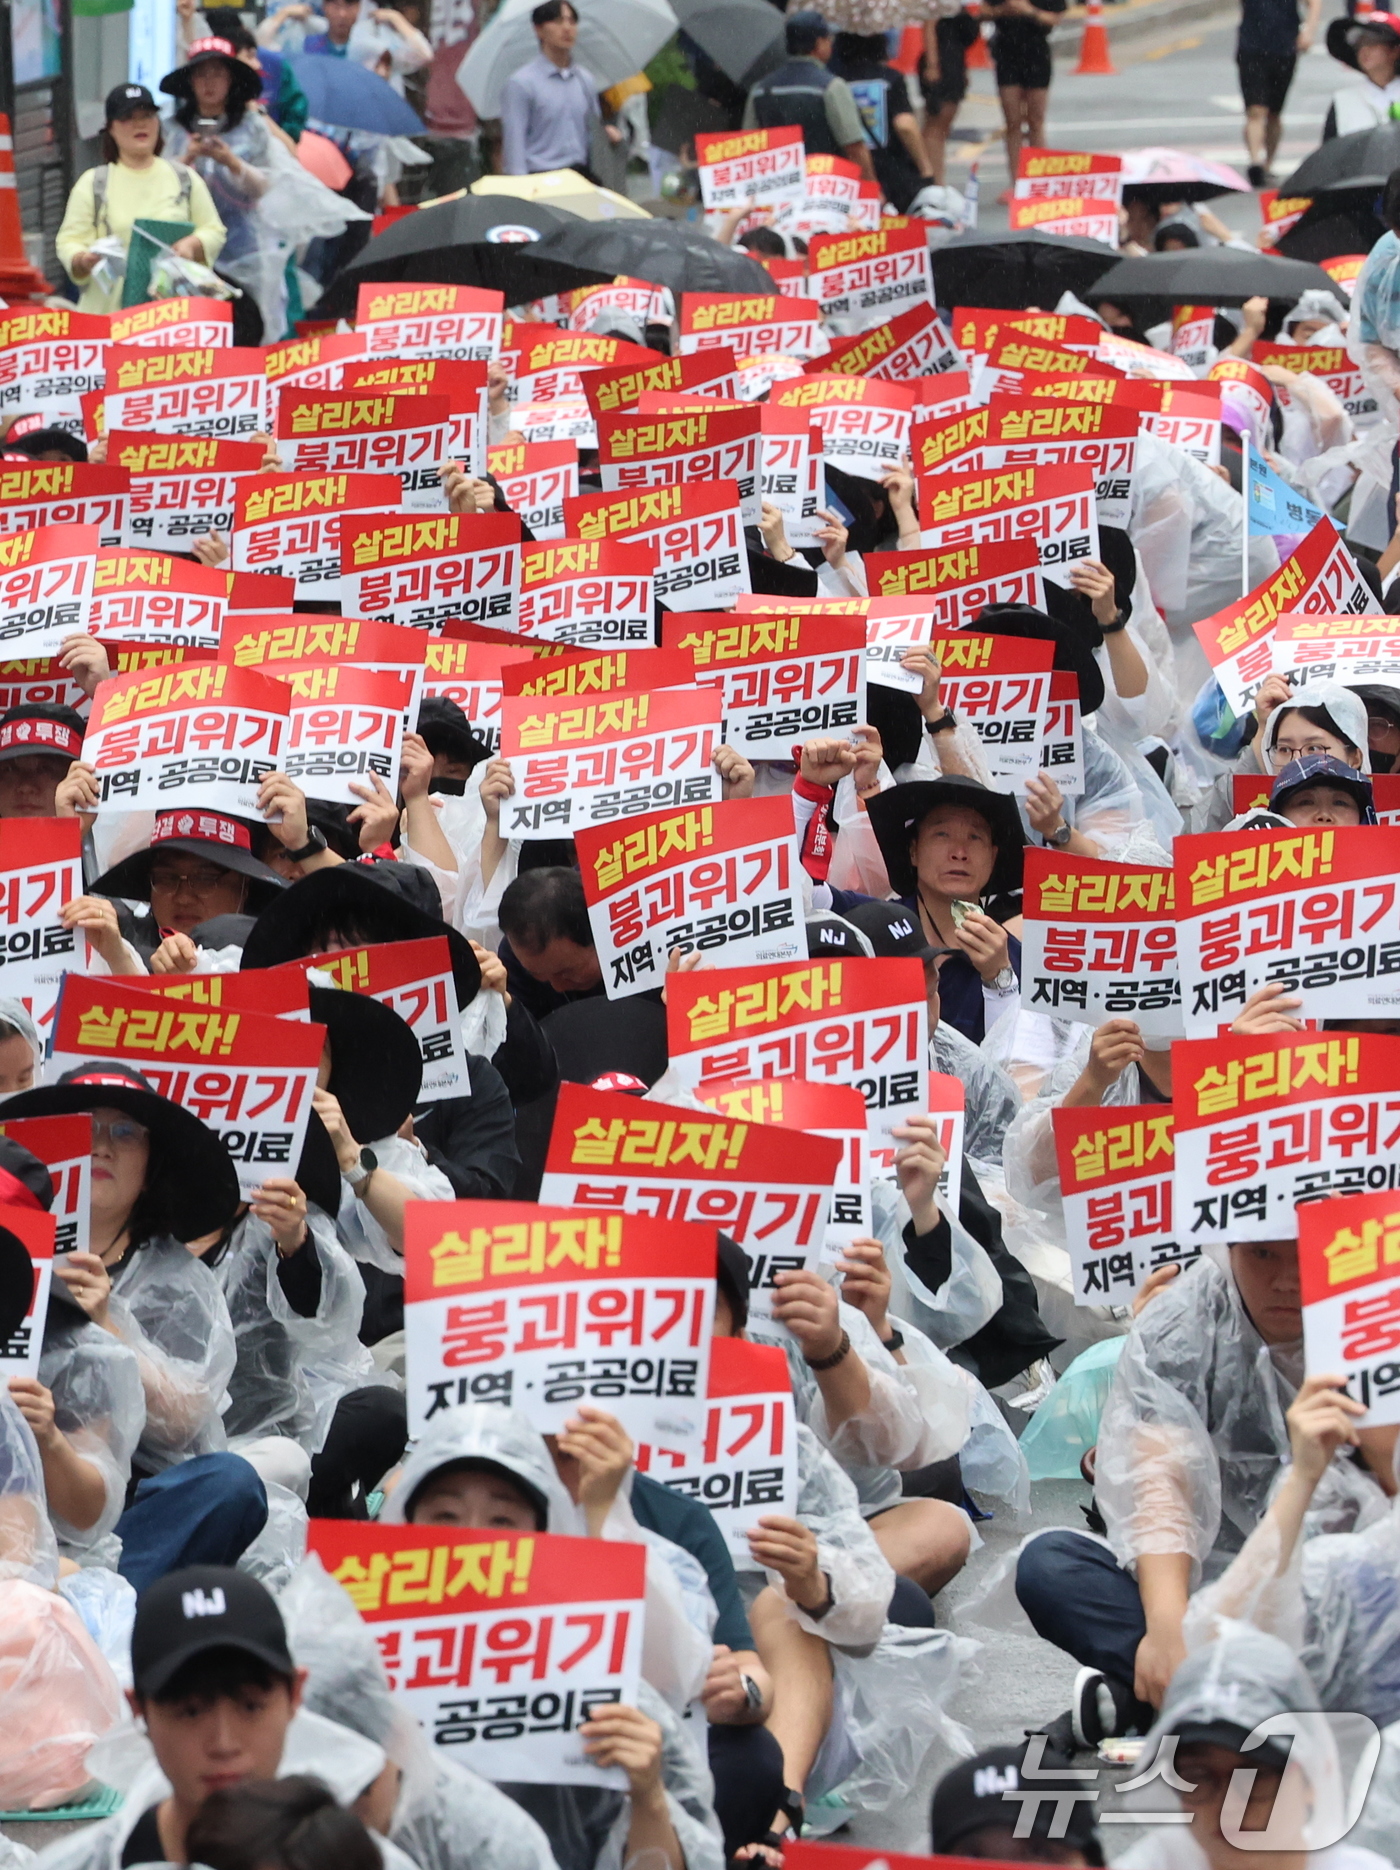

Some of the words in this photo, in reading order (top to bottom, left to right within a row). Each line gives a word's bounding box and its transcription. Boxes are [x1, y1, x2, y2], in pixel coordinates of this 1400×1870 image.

[816, 232, 887, 268] 살리자!
[821, 252, 925, 298] 붕괴위기
[110, 299, 189, 341] 살리자!
[368, 287, 457, 320] 살리자!
[692, 297, 775, 329] 살리자!
[370, 318, 495, 352] 붕괴위기
[530, 339, 618, 370] 살리자!
[117, 349, 214, 389] 살리자!
[596, 358, 683, 411] 살리자!
[777, 379, 867, 407] 살리자!
[122, 379, 261, 427] 붕괴위기
[291, 397, 395, 433] 살리자!
[1000, 405, 1103, 439] 살리자!
[119, 441, 218, 473] 살리자!
[294, 428, 444, 472] 붕괴위기
[609, 414, 708, 457] 살리자!
[0, 466, 74, 500] 리자!
[245, 475, 347, 523] 살리자!
[931, 468, 1035, 521] 살리자!
[577, 486, 682, 539] 살리자!
[352, 516, 460, 566] 살리자!
[358, 549, 514, 613] 붕괴위기
[521, 542, 600, 589] 리자!
[878, 547, 979, 596] 살리자!
[1216, 556, 1308, 655] 살리자!
[233, 621, 360, 667] 살리자!
[678, 615, 801, 666] 살리자!
[101, 665, 228, 726] 살리자!
[35, 720, 70, 748] 투쟁
[95, 711, 282, 769] 붕괴위기
[517, 693, 650, 749] 살리자!
[522, 729, 713, 798] 붕괴위기
[509, 798, 572, 832] 지역
[590, 774, 713, 821] 공공의료
[198, 818, 236, 844] 투쟁
[593, 807, 713, 892] 살리자!
[1039, 872, 1174, 914] 살리자!
[1189, 831, 1335, 907] 살리자!
[608, 843, 791, 949] 붕괴위기
[610, 949, 655, 989] 지역
[665, 897, 795, 959] 공공의료
[820, 927, 846, 946] NJ
[887, 920, 914, 941] NJ
[686, 961, 843, 1043] 살리자!
[1031, 978, 1087, 1011] 지역
[1191, 970, 1246, 1016] 지역
[76, 1005, 241, 1055] 살리자!
[1192, 1036, 1361, 1117] 살리자!
[571, 1116, 749, 1170] 살리자!
[1190, 1185, 1267, 1233] 지역
[429, 1215, 623, 1287] 살리자!
[1081, 1251, 1136, 1296] 지역
[442, 1287, 706, 1369] 붕괴위기
[424, 1370, 514, 1421] 지역
[544, 1358, 698, 1404] 공공의료
[330, 1538, 536, 1613] 살리자!
[182, 1585, 227, 1620] NJ
[972, 1762, 1020, 1799] NJ
